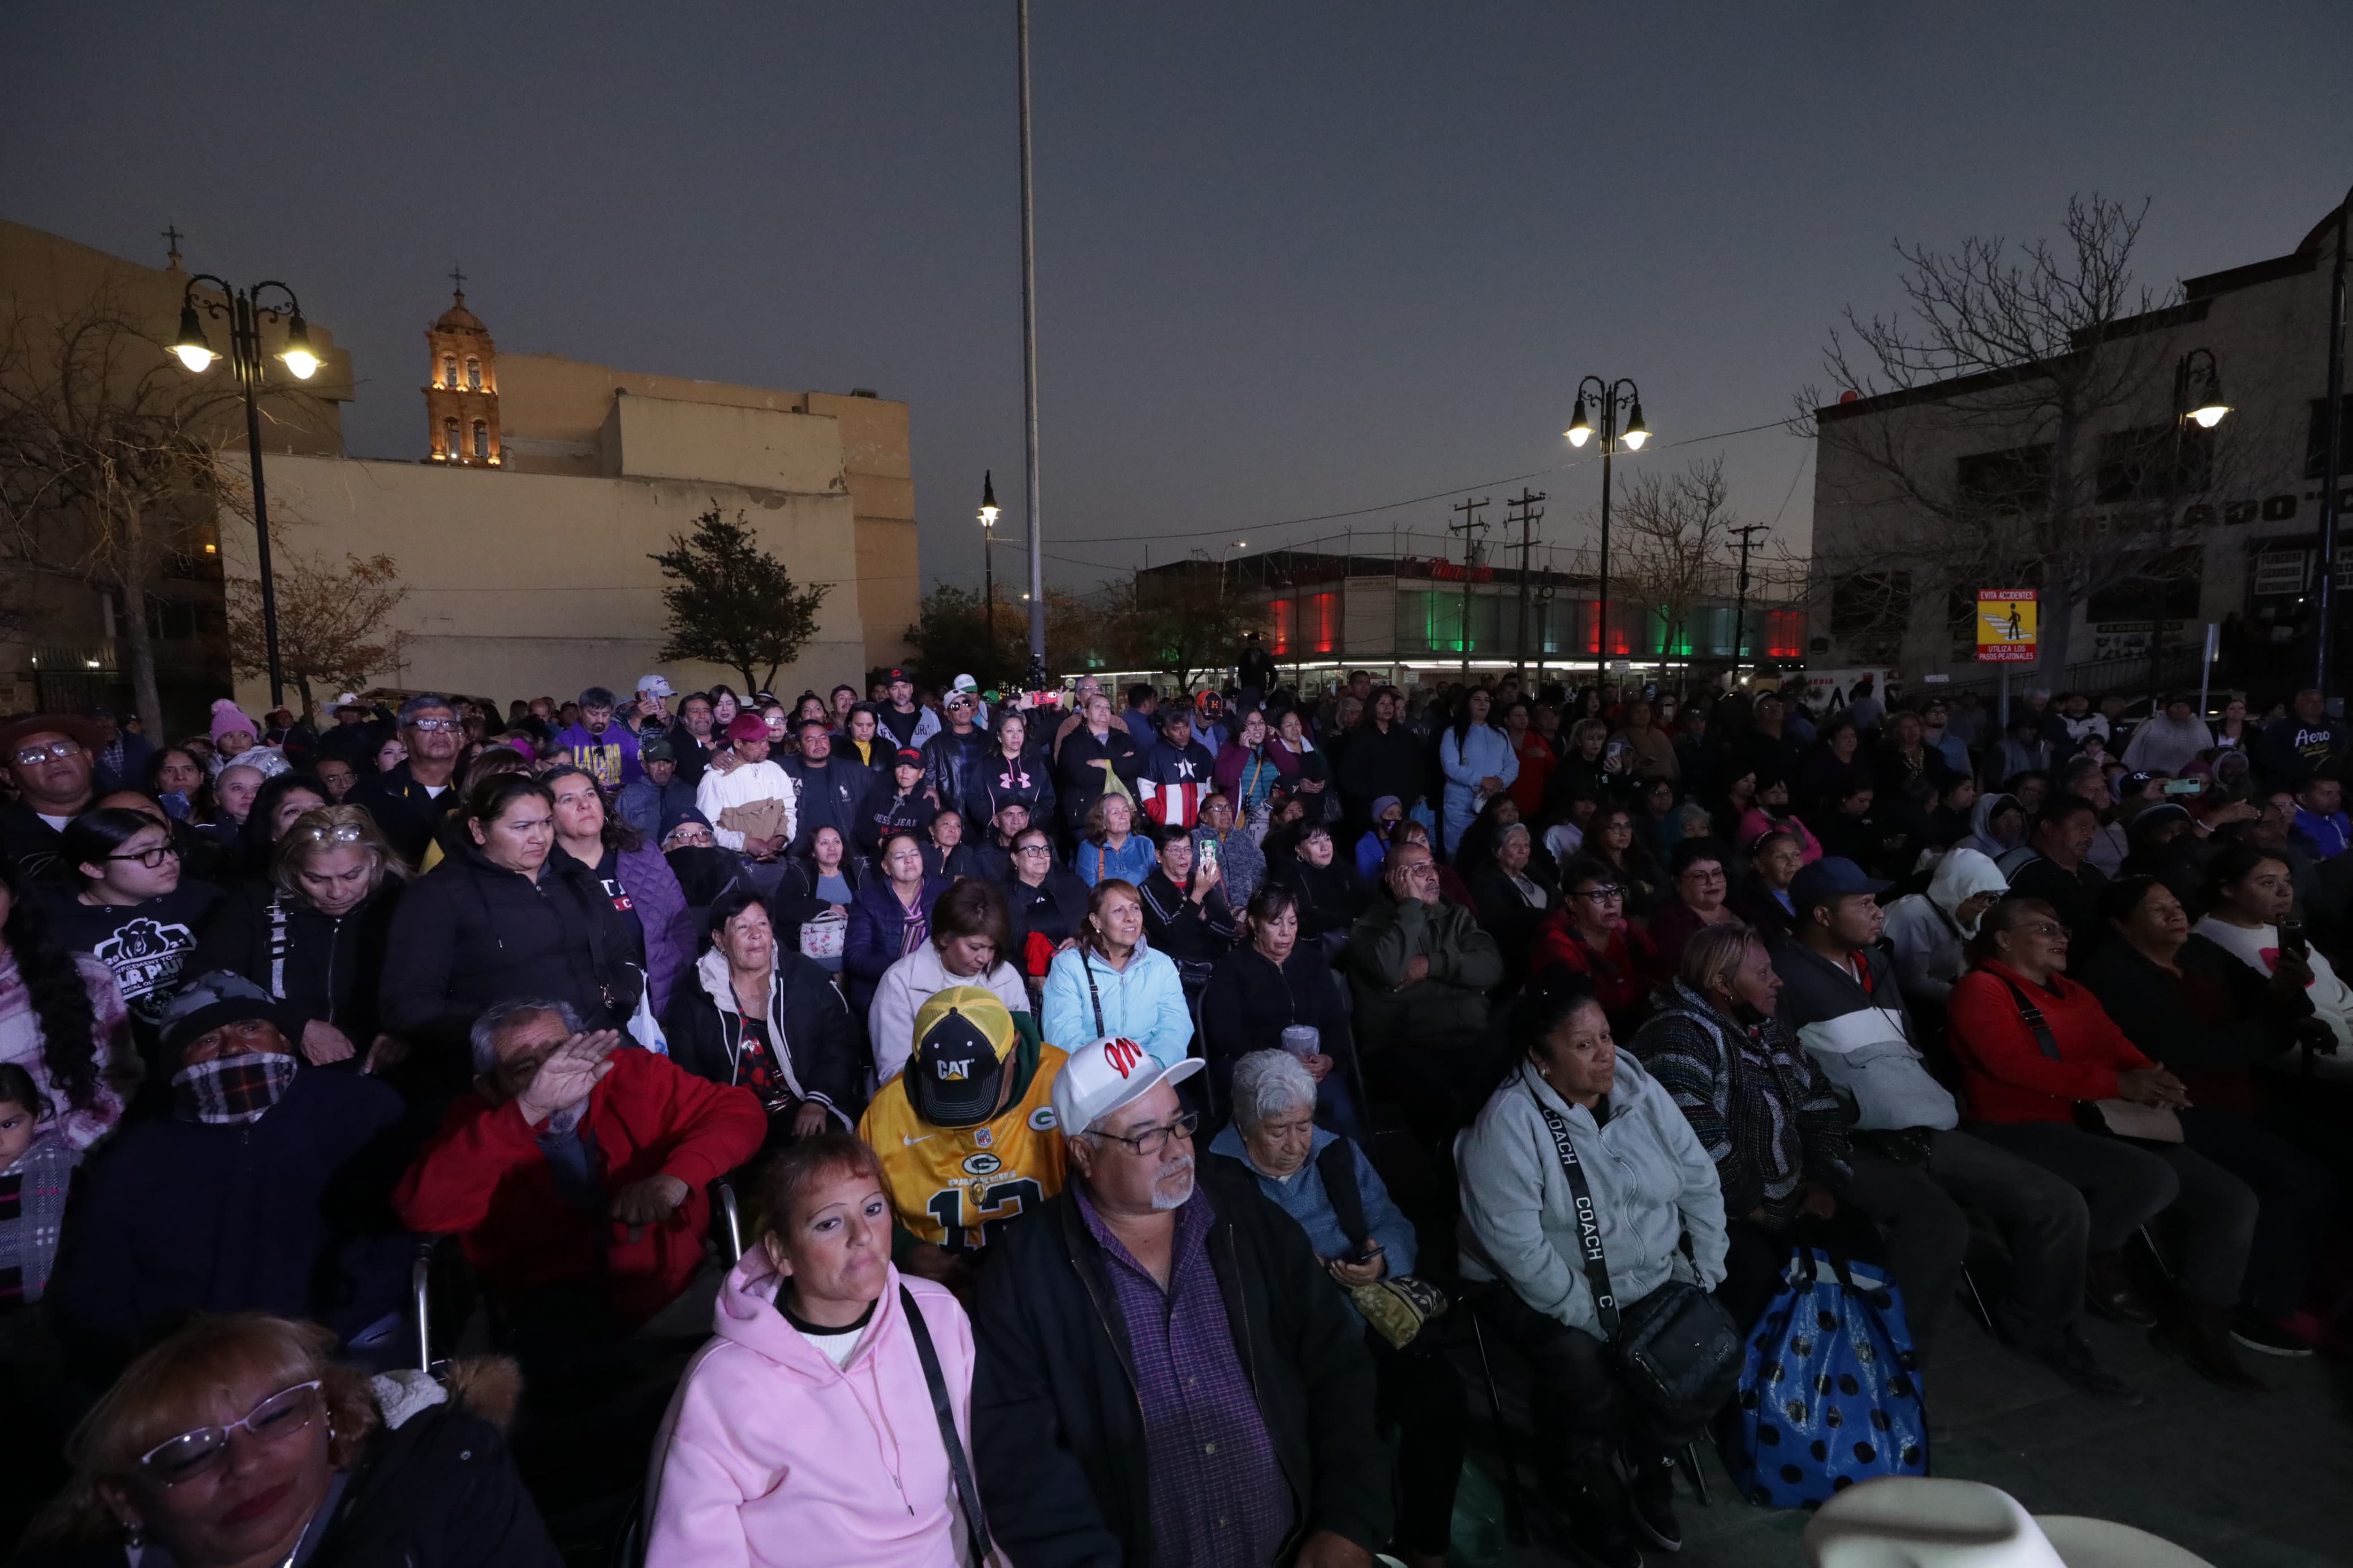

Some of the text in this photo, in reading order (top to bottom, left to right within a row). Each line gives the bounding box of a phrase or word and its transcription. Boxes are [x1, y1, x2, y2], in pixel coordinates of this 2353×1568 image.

[1980, 591, 2033, 599] EVITA ACCIDENTES
[1998, 652, 2033, 660] PEATONALES
[2294, 729, 2330, 748] Aero
[937, 1059, 971, 1079] CAT
[978, 1135, 991, 1144] NFL
[1542, 1109, 1578, 1164] COACH
[1576, 1196, 1603, 1261] COACH
